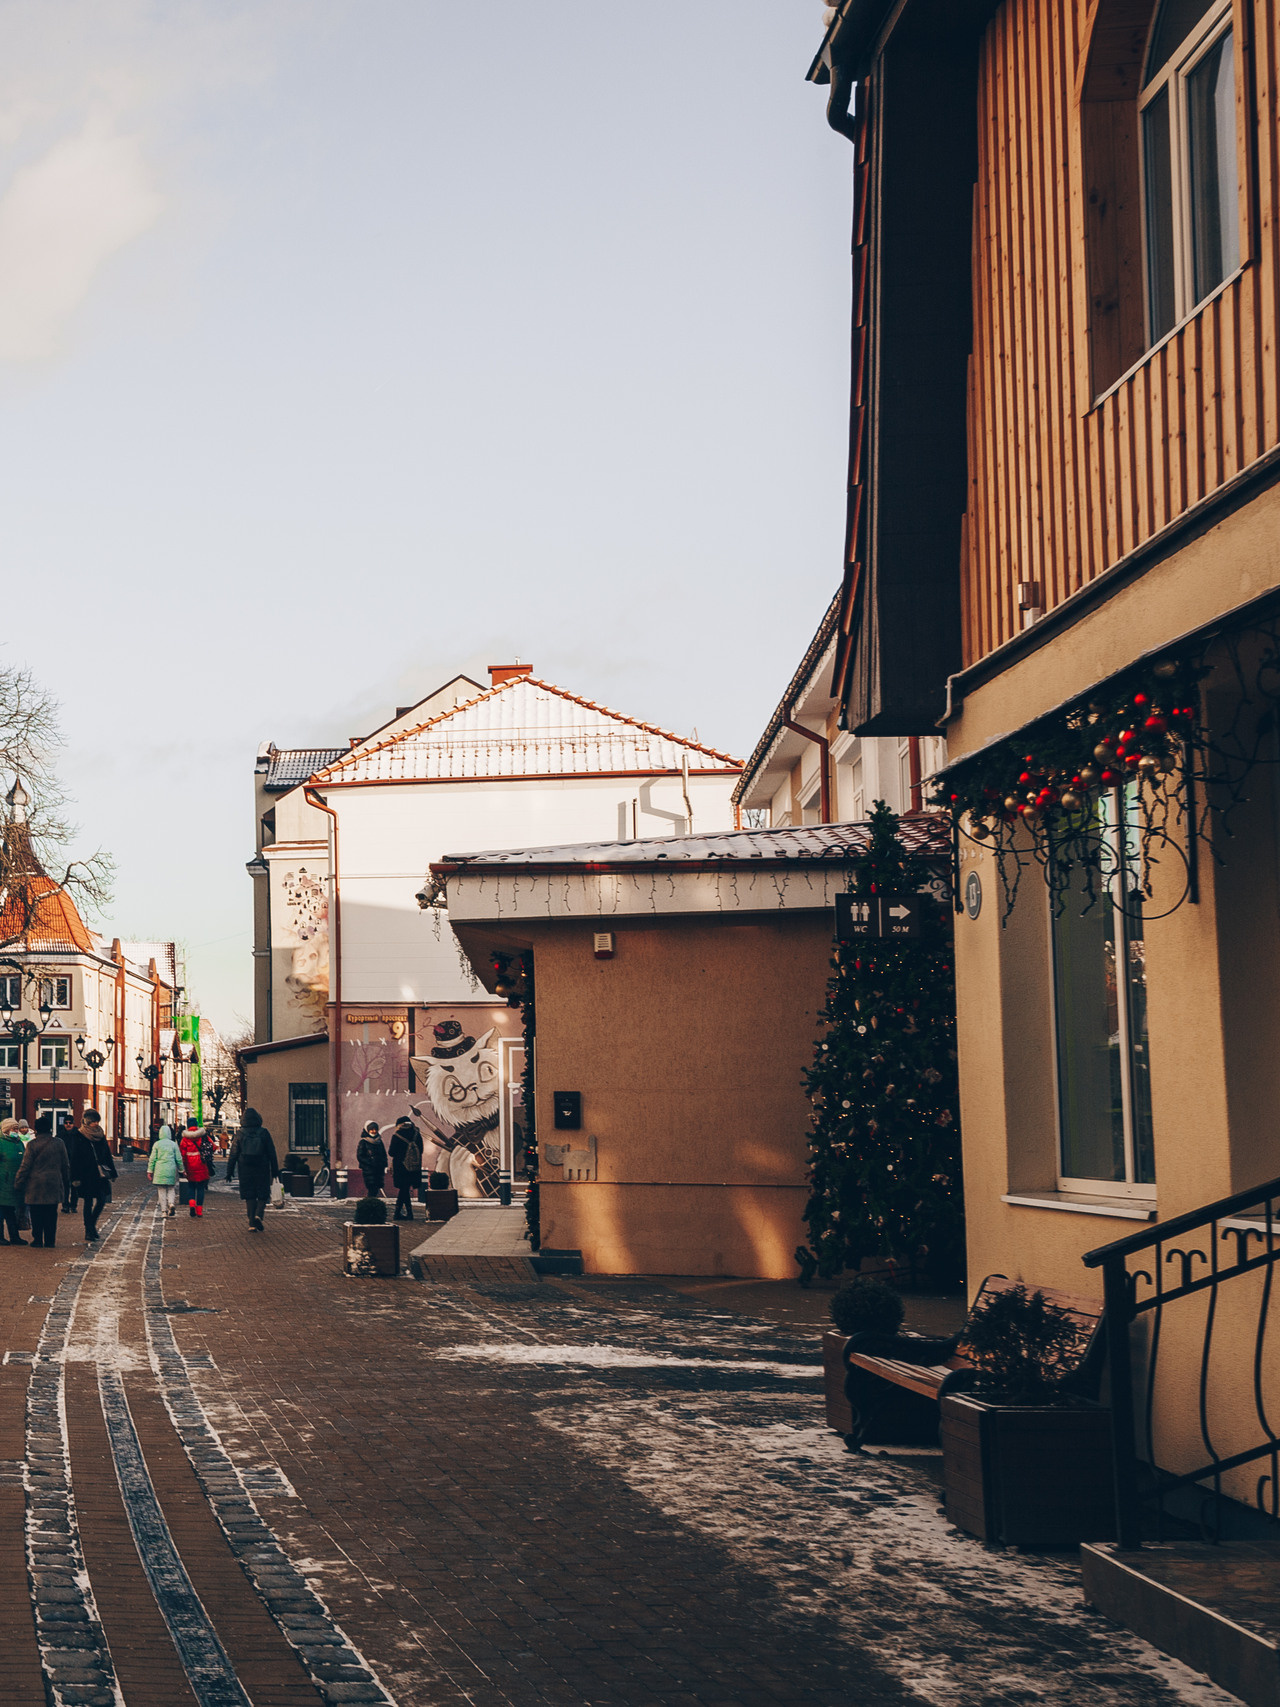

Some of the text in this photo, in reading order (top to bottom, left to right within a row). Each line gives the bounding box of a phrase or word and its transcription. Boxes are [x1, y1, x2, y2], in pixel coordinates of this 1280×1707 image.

[853, 925, 869, 933] WC
[891, 925, 901, 933] 50
[392, 1021, 405, 1039] 9
